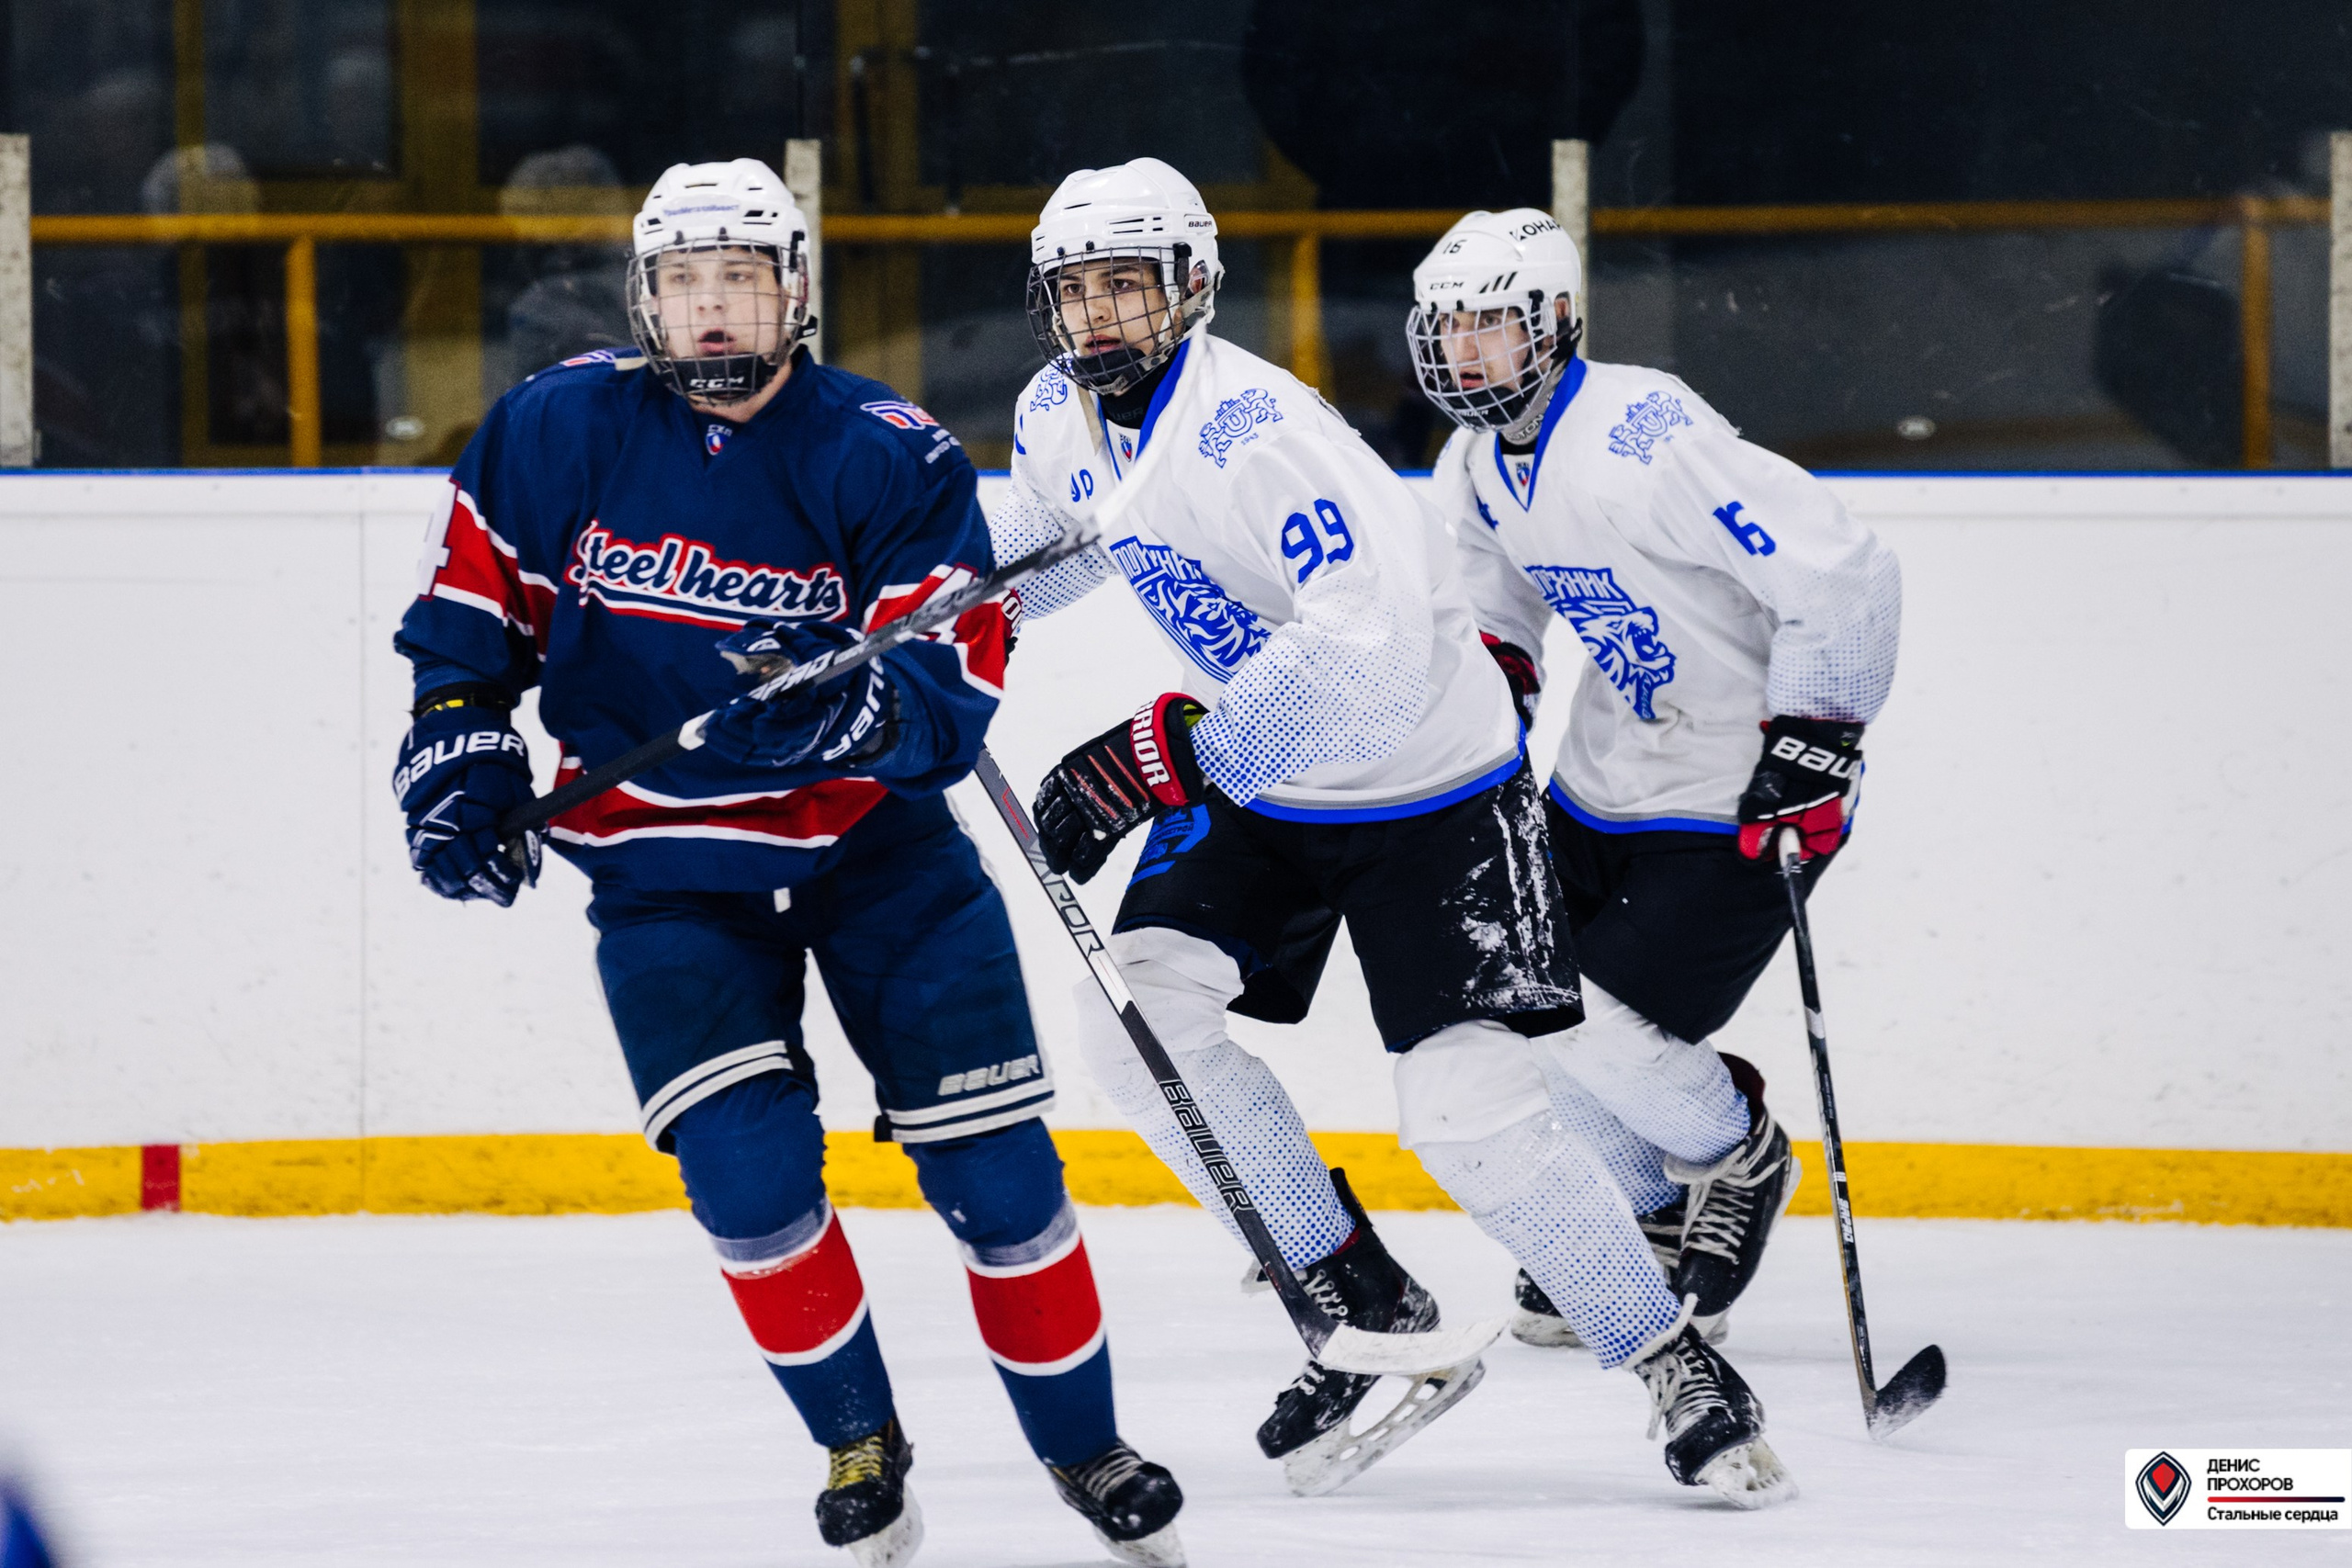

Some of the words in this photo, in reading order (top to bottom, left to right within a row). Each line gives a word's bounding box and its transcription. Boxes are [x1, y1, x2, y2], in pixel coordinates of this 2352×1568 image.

[1443, 239, 1468, 254] 16
[1430, 281, 1464, 290] CCM
[689, 377, 745, 389] CCM
[567, 519, 682, 594] Steel
[673, 543, 844, 615] hearts
[1281, 498, 1354, 583] 99
[821, 655, 885, 762] UER
[393, 730, 526, 804] BAUER
[937, 1053, 1041, 1097] BAUER
[1159, 1078, 1257, 1215] BAUER
